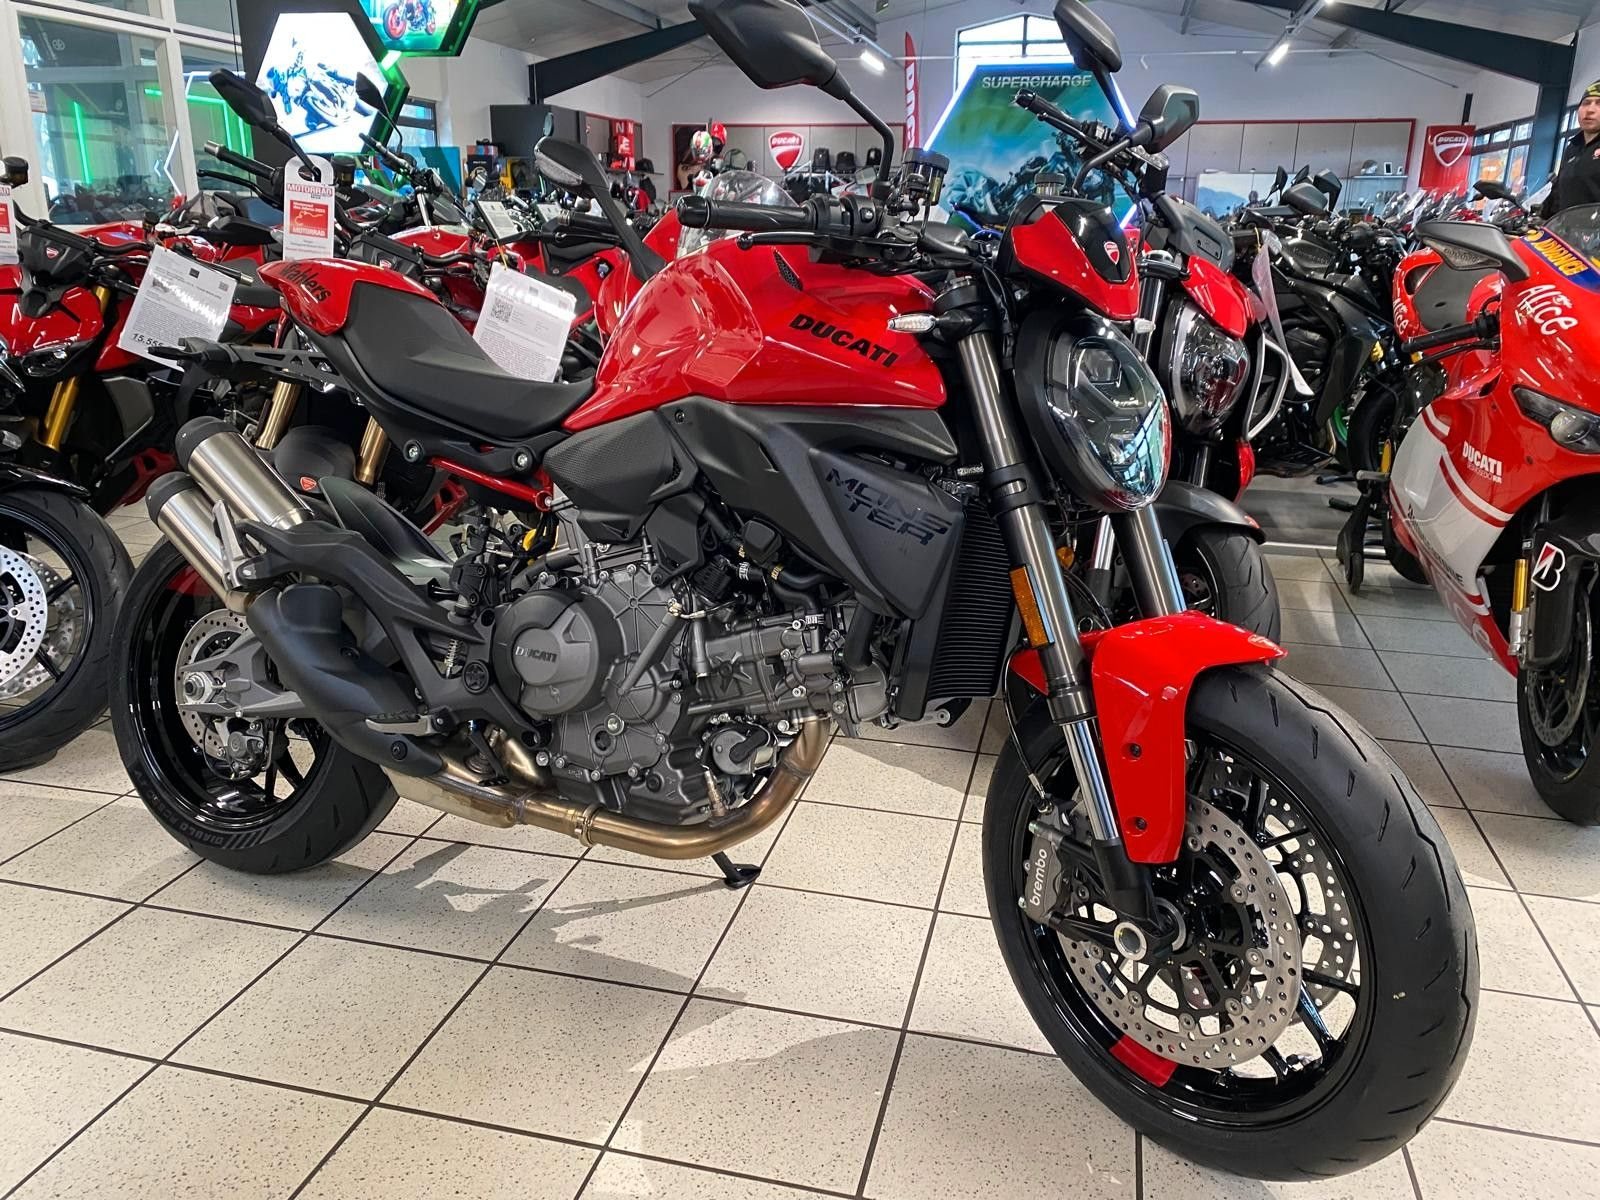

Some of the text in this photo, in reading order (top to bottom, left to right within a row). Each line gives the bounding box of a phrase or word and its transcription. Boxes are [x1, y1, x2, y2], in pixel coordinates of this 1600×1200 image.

[982, 75, 1093, 89] SUPERCHARGE
[286, 183, 333, 197] MOTORRAD
[1517, 284, 1579, 335] Alice
[789, 313, 900, 368] DUCATI
[1462, 440, 1503, 477] DUCATI
[825, 467, 953, 536] MONS
[515, 645, 558, 663] DUCATI
[1029, 848, 1048, 906] brembo
